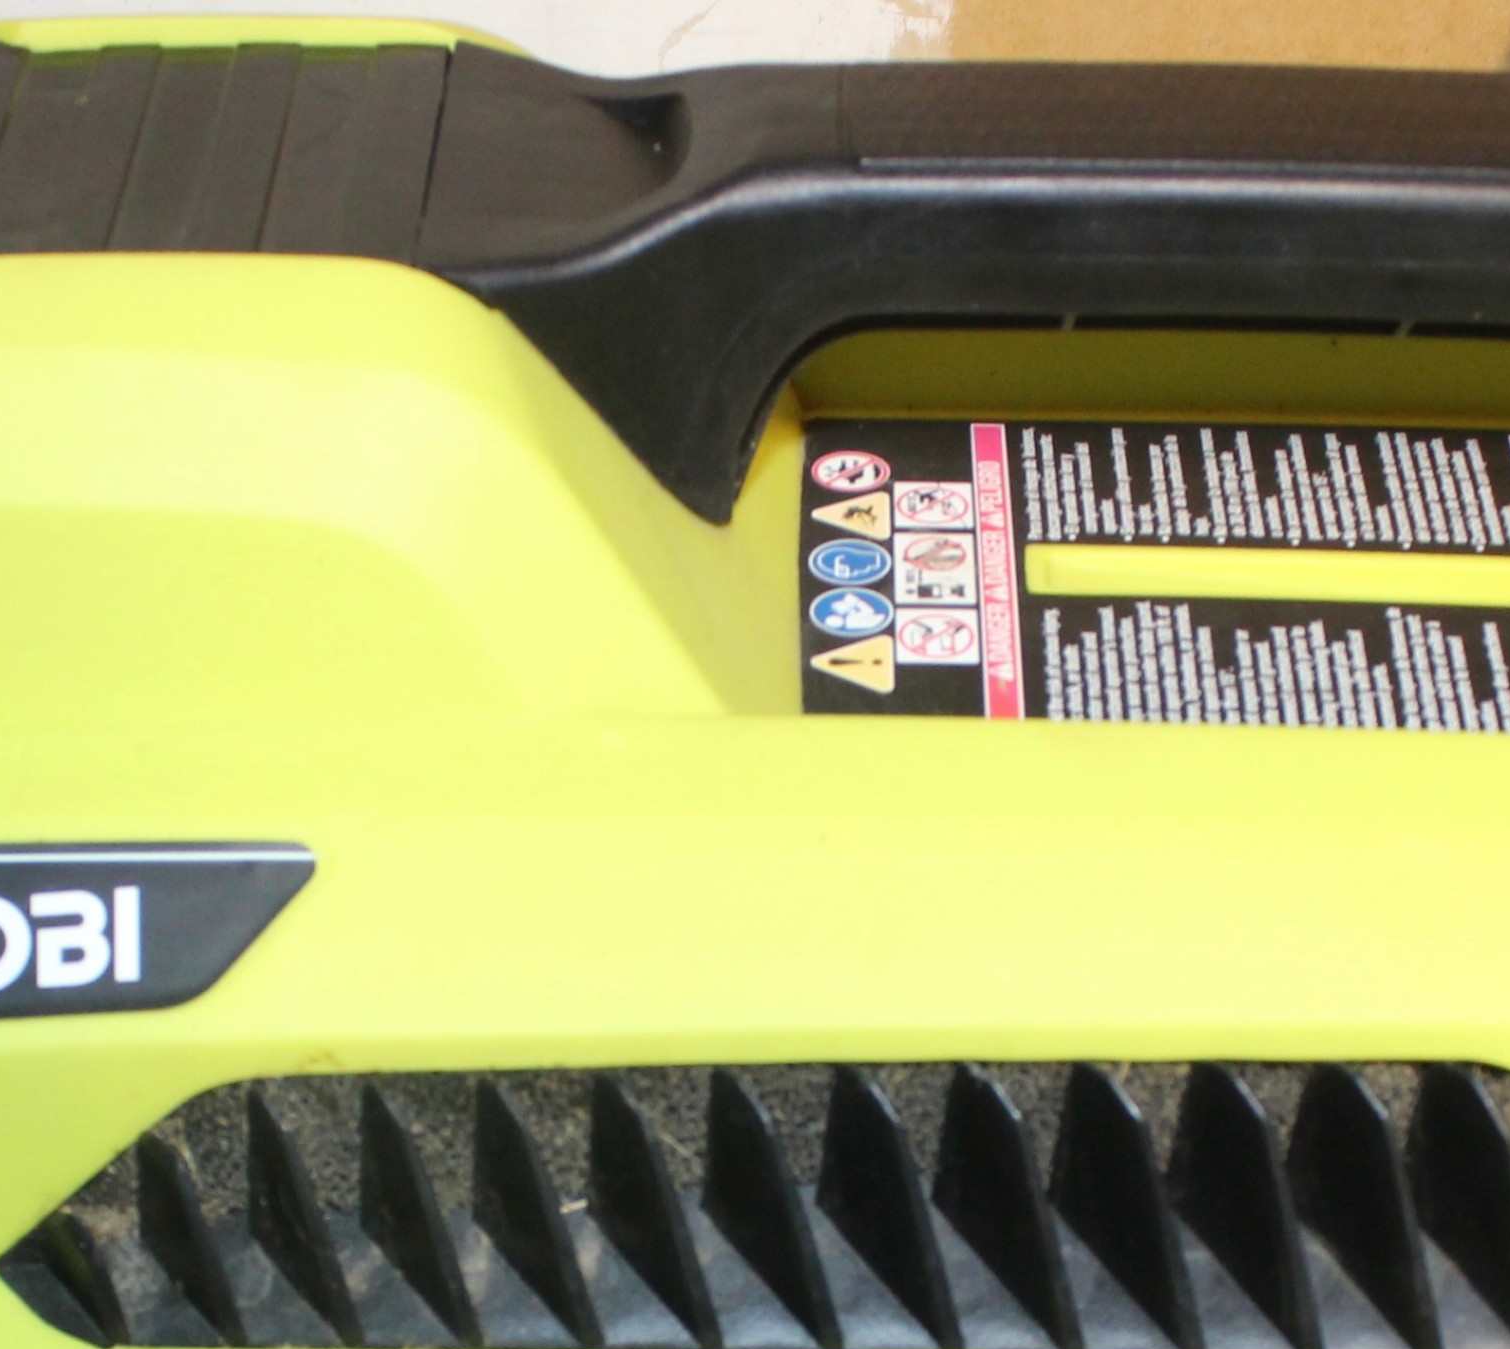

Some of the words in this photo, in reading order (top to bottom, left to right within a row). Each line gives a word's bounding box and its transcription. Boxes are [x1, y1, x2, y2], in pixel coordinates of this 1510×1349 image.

[977, 460, 1005, 513] PELIGRO
[981, 530, 1010, 585] DANGER
[985, 603, 1014, 664] DANGER
